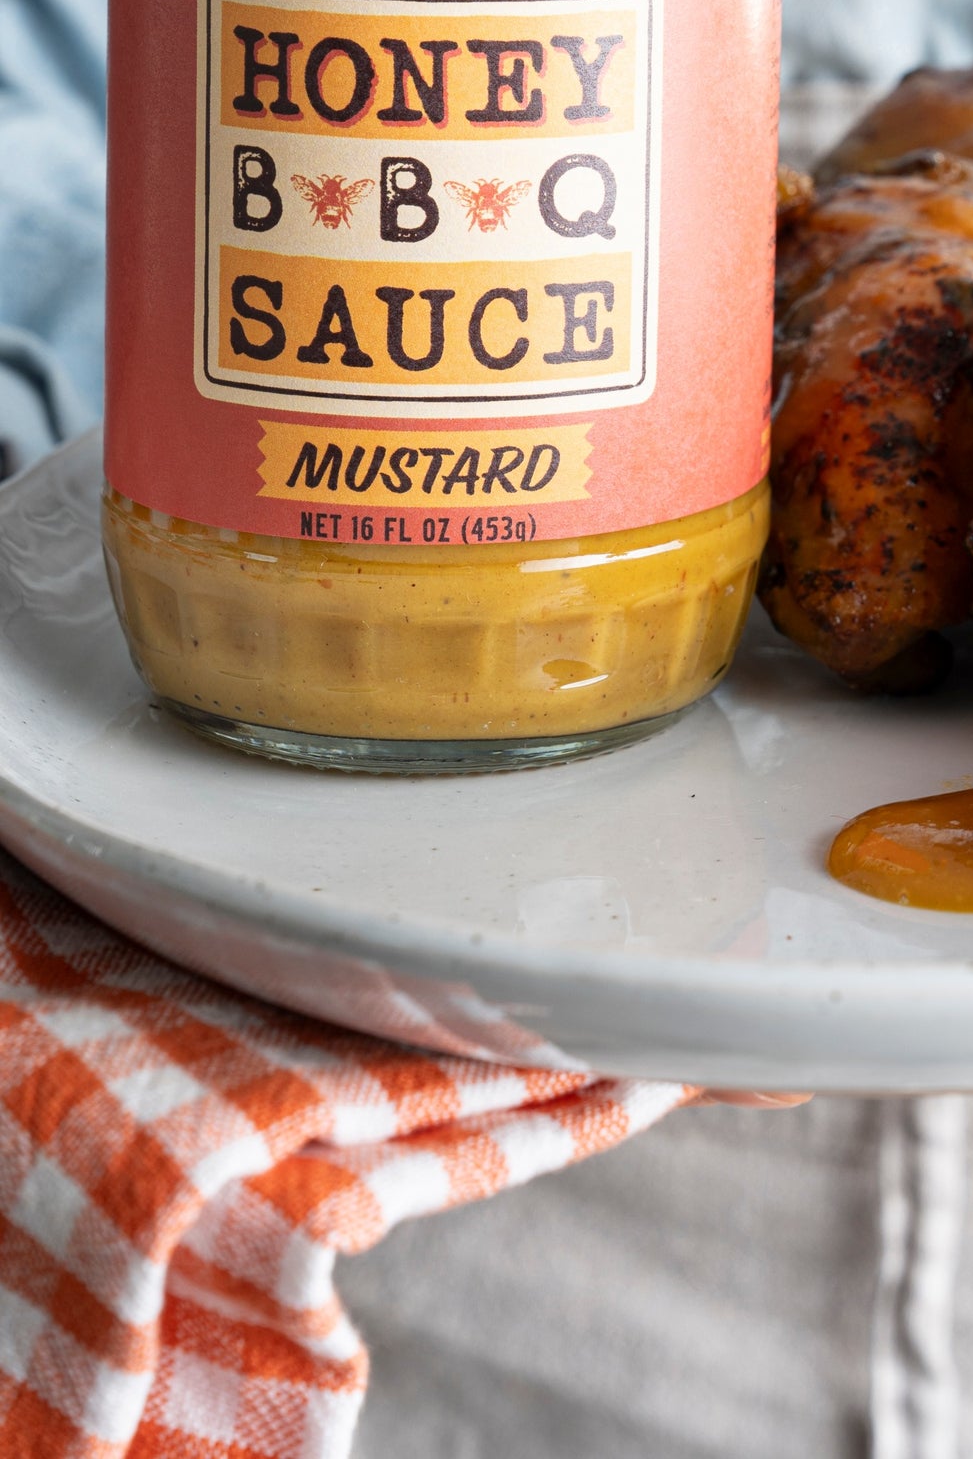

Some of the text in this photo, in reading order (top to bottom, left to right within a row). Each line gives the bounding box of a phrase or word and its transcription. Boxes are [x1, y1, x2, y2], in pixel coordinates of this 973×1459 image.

[232, 24, 625, 128] HONEY
[233, 144, 616, 243] B B Q
[230, 274, 615, 371] SAUCE
[286, 441, 561, 495] MUSTARD
[300, 511, 342, 540] NET
[351, 515, 374, 541] 16
[384, 517, 412, 543] FL
[422, 517, 450, 542] OZ
